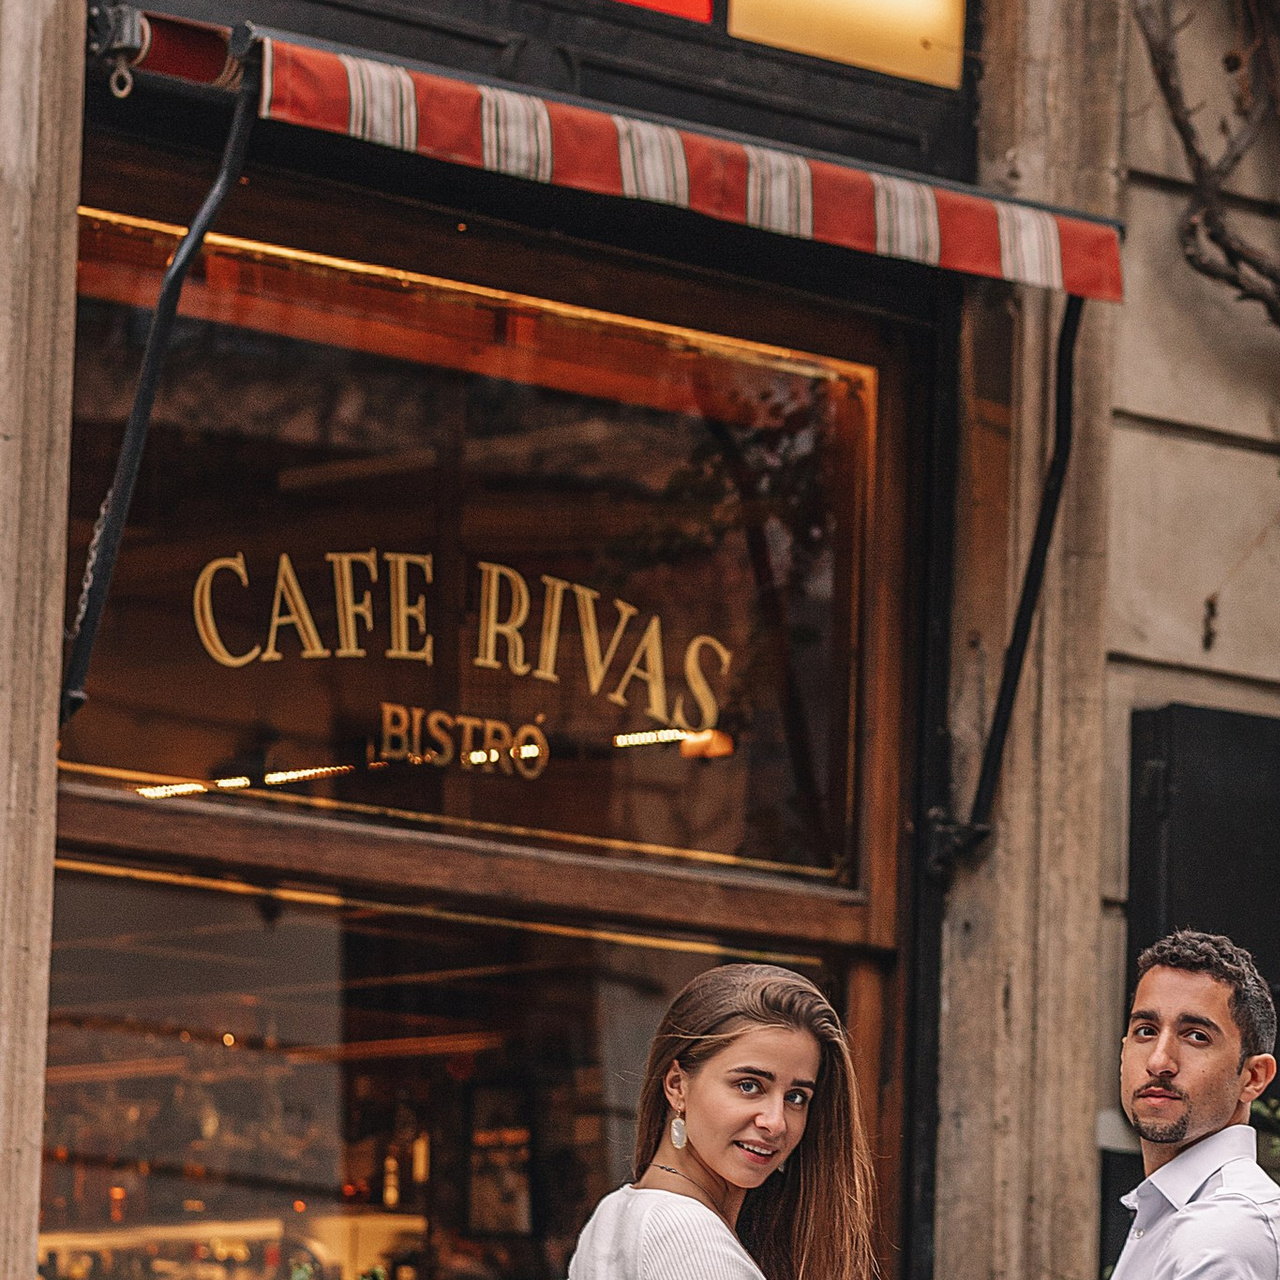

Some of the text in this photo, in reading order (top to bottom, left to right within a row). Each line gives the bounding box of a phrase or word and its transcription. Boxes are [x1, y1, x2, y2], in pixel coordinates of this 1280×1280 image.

[193, 548, 731, 732] CAFE RIVAS
[380, 701, 549, 780] BISTRÓ
